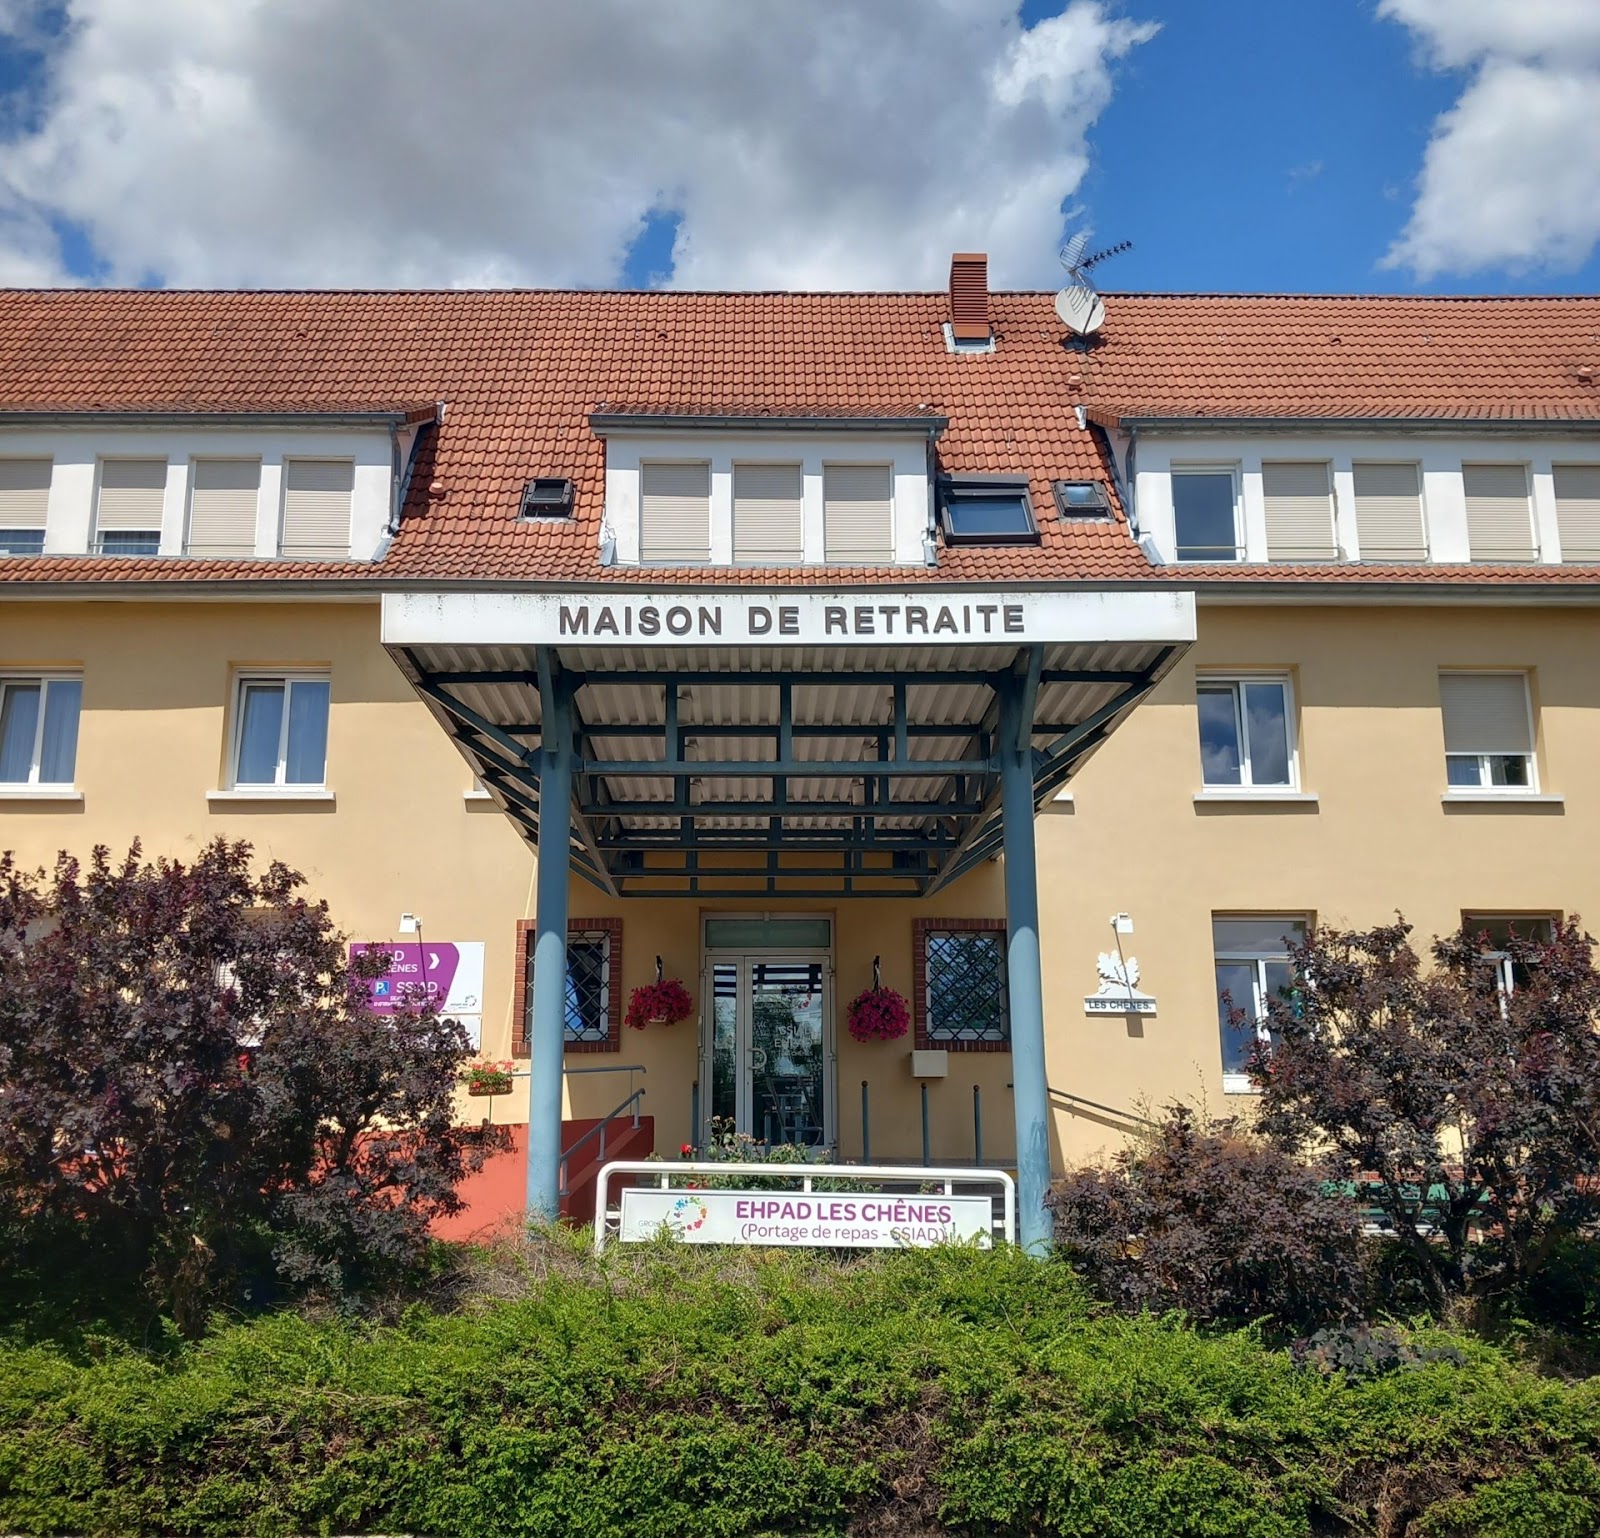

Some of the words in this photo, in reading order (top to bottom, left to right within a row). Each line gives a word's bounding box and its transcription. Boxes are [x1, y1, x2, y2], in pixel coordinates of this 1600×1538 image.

[559, 606, 722, 636] MAISON
[748, 606, 800, 636] DE
[824, 605, 1025, 635] RETRAITE
[1089, 1001, 1107, 1009] LES
[736, 1201, 812, 1220] EHPAD
[817, 1203, 857, 1221] LES
[861, 1199, 951, 1223] CHÊNES
[741, 1223, 808, 1241] (Portage
[812, 1225, 831, 1238] de
[835, 1228, 878, 1242] repas
